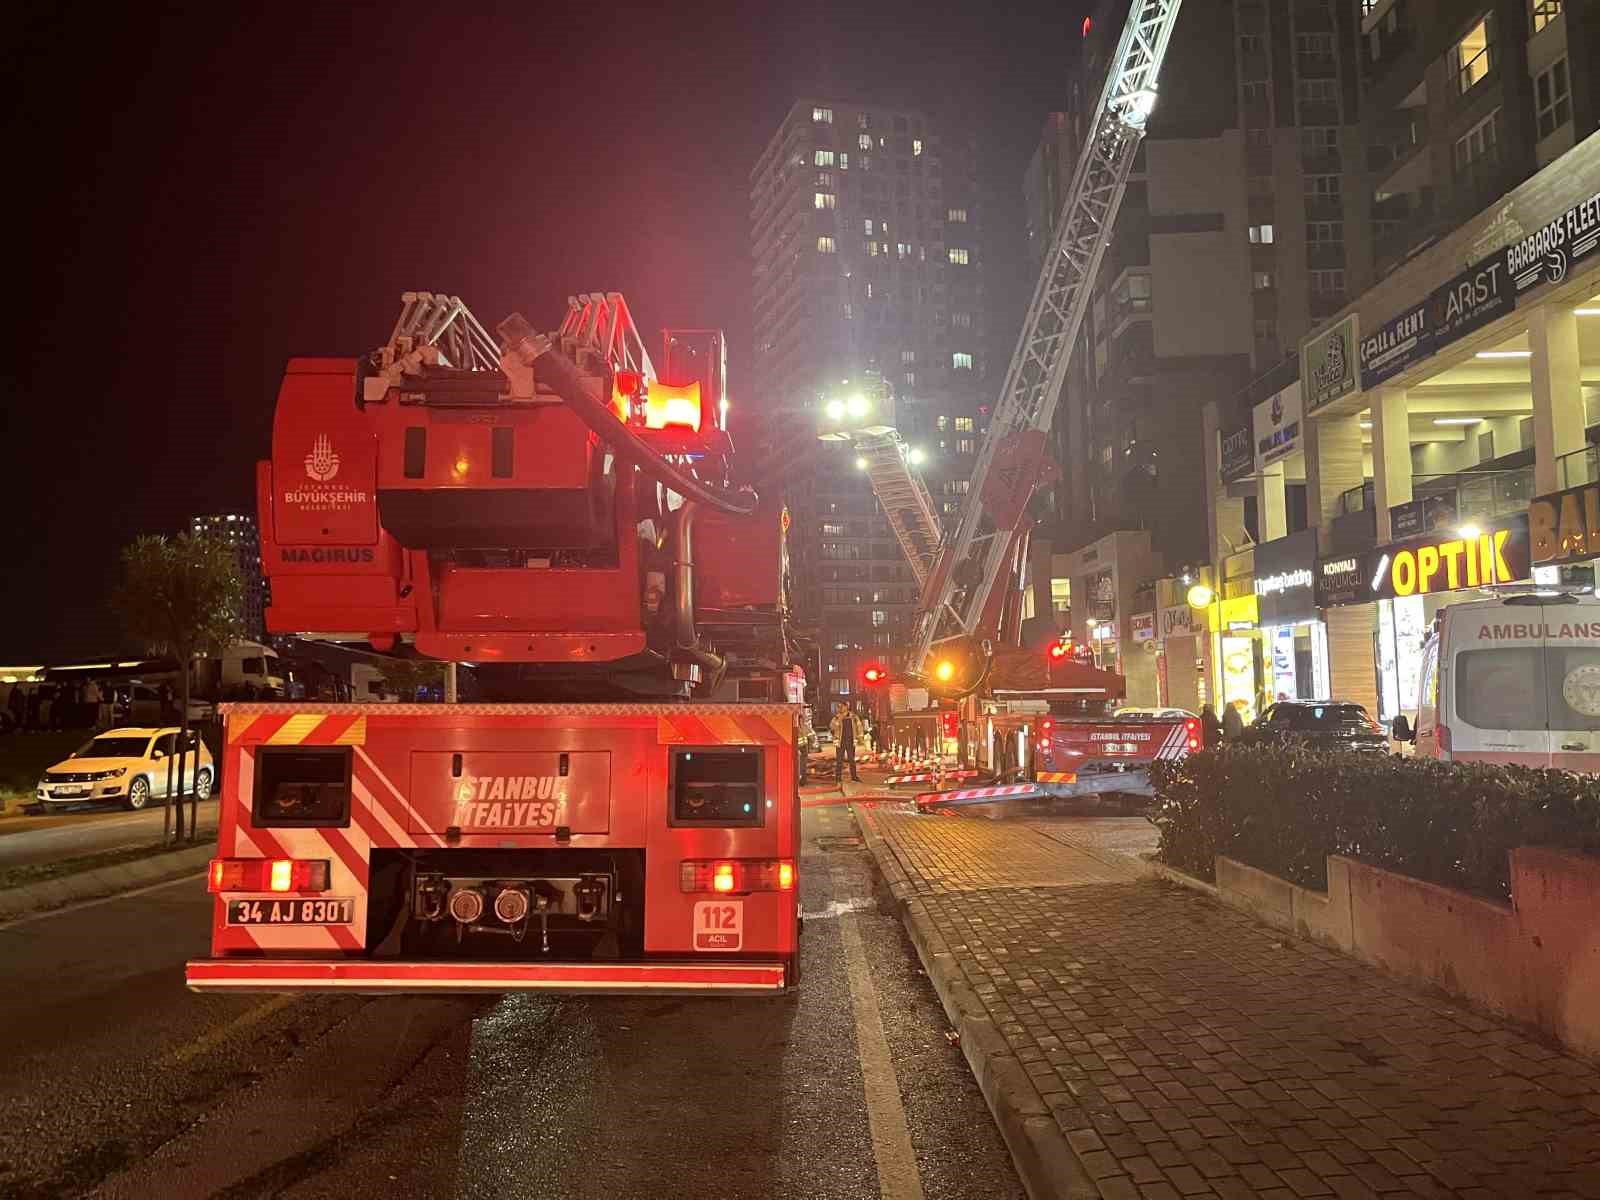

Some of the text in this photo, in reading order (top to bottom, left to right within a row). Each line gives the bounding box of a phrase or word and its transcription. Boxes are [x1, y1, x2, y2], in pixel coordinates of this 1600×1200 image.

[1507, 216, 1565, 275] BARBAROS
[1396, 308, 1424, 343] RENT
[285, 489, 367, 505] BÜYÜKŞEHİR
[281, 547, 375, 562] MAGIRUS
[1323, 558, 1356, 575] KONYALI
[1478, 622, 1600, 640] AMBULANS
[237, 900, 352, 922] 34 AJ 8301
[703, 906, 736, 928] 112
